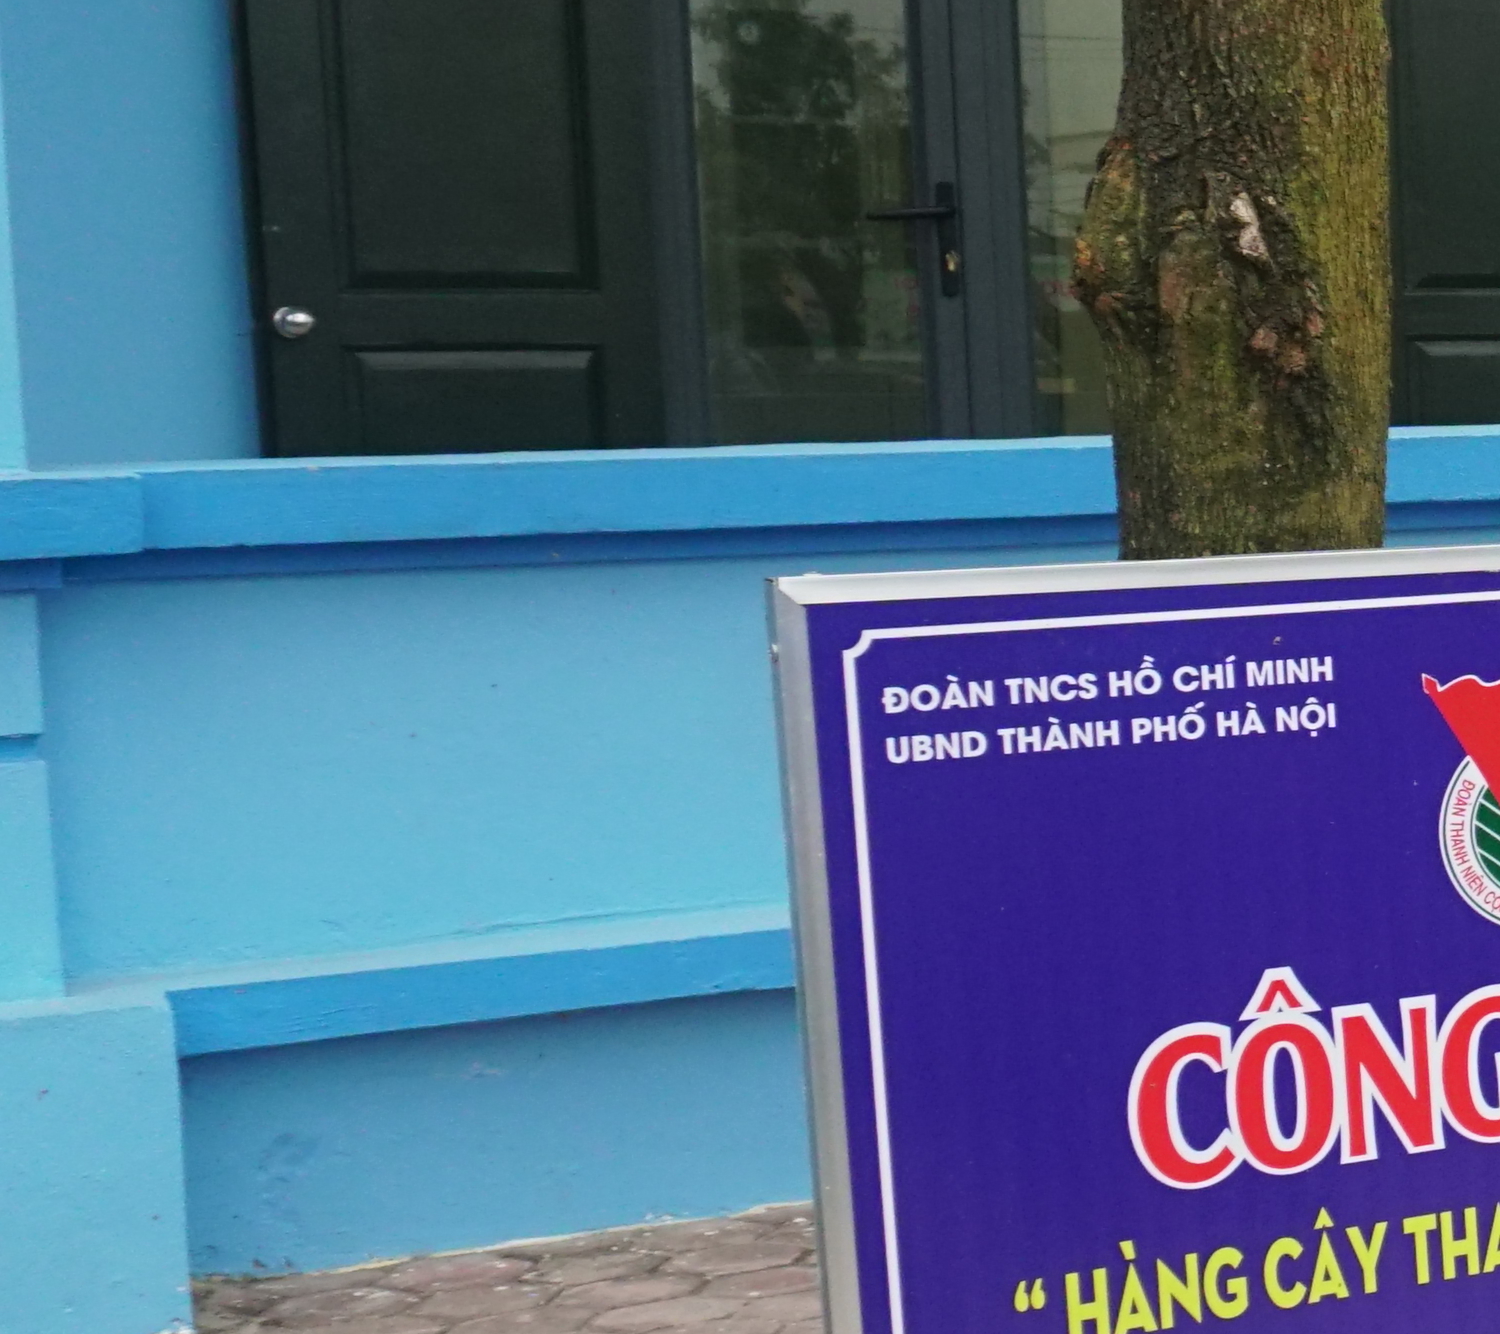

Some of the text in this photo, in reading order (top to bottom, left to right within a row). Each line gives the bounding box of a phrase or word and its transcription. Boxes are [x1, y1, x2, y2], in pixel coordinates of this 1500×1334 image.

[882, 654, 1334, 714] ĐOÀN TNCS HỒ CHÍ MINH
[885, 696, 1337, 764] UBND THÀNH PHỐ HÀ NỘI
[1452, 779, 1476, 818] ĐOÀN
[1450, 820, 1471, 866] THANH
[1461, 865, 1487, 898] NIÊN
[1264, 1206, 1388, 1309] CÂY
